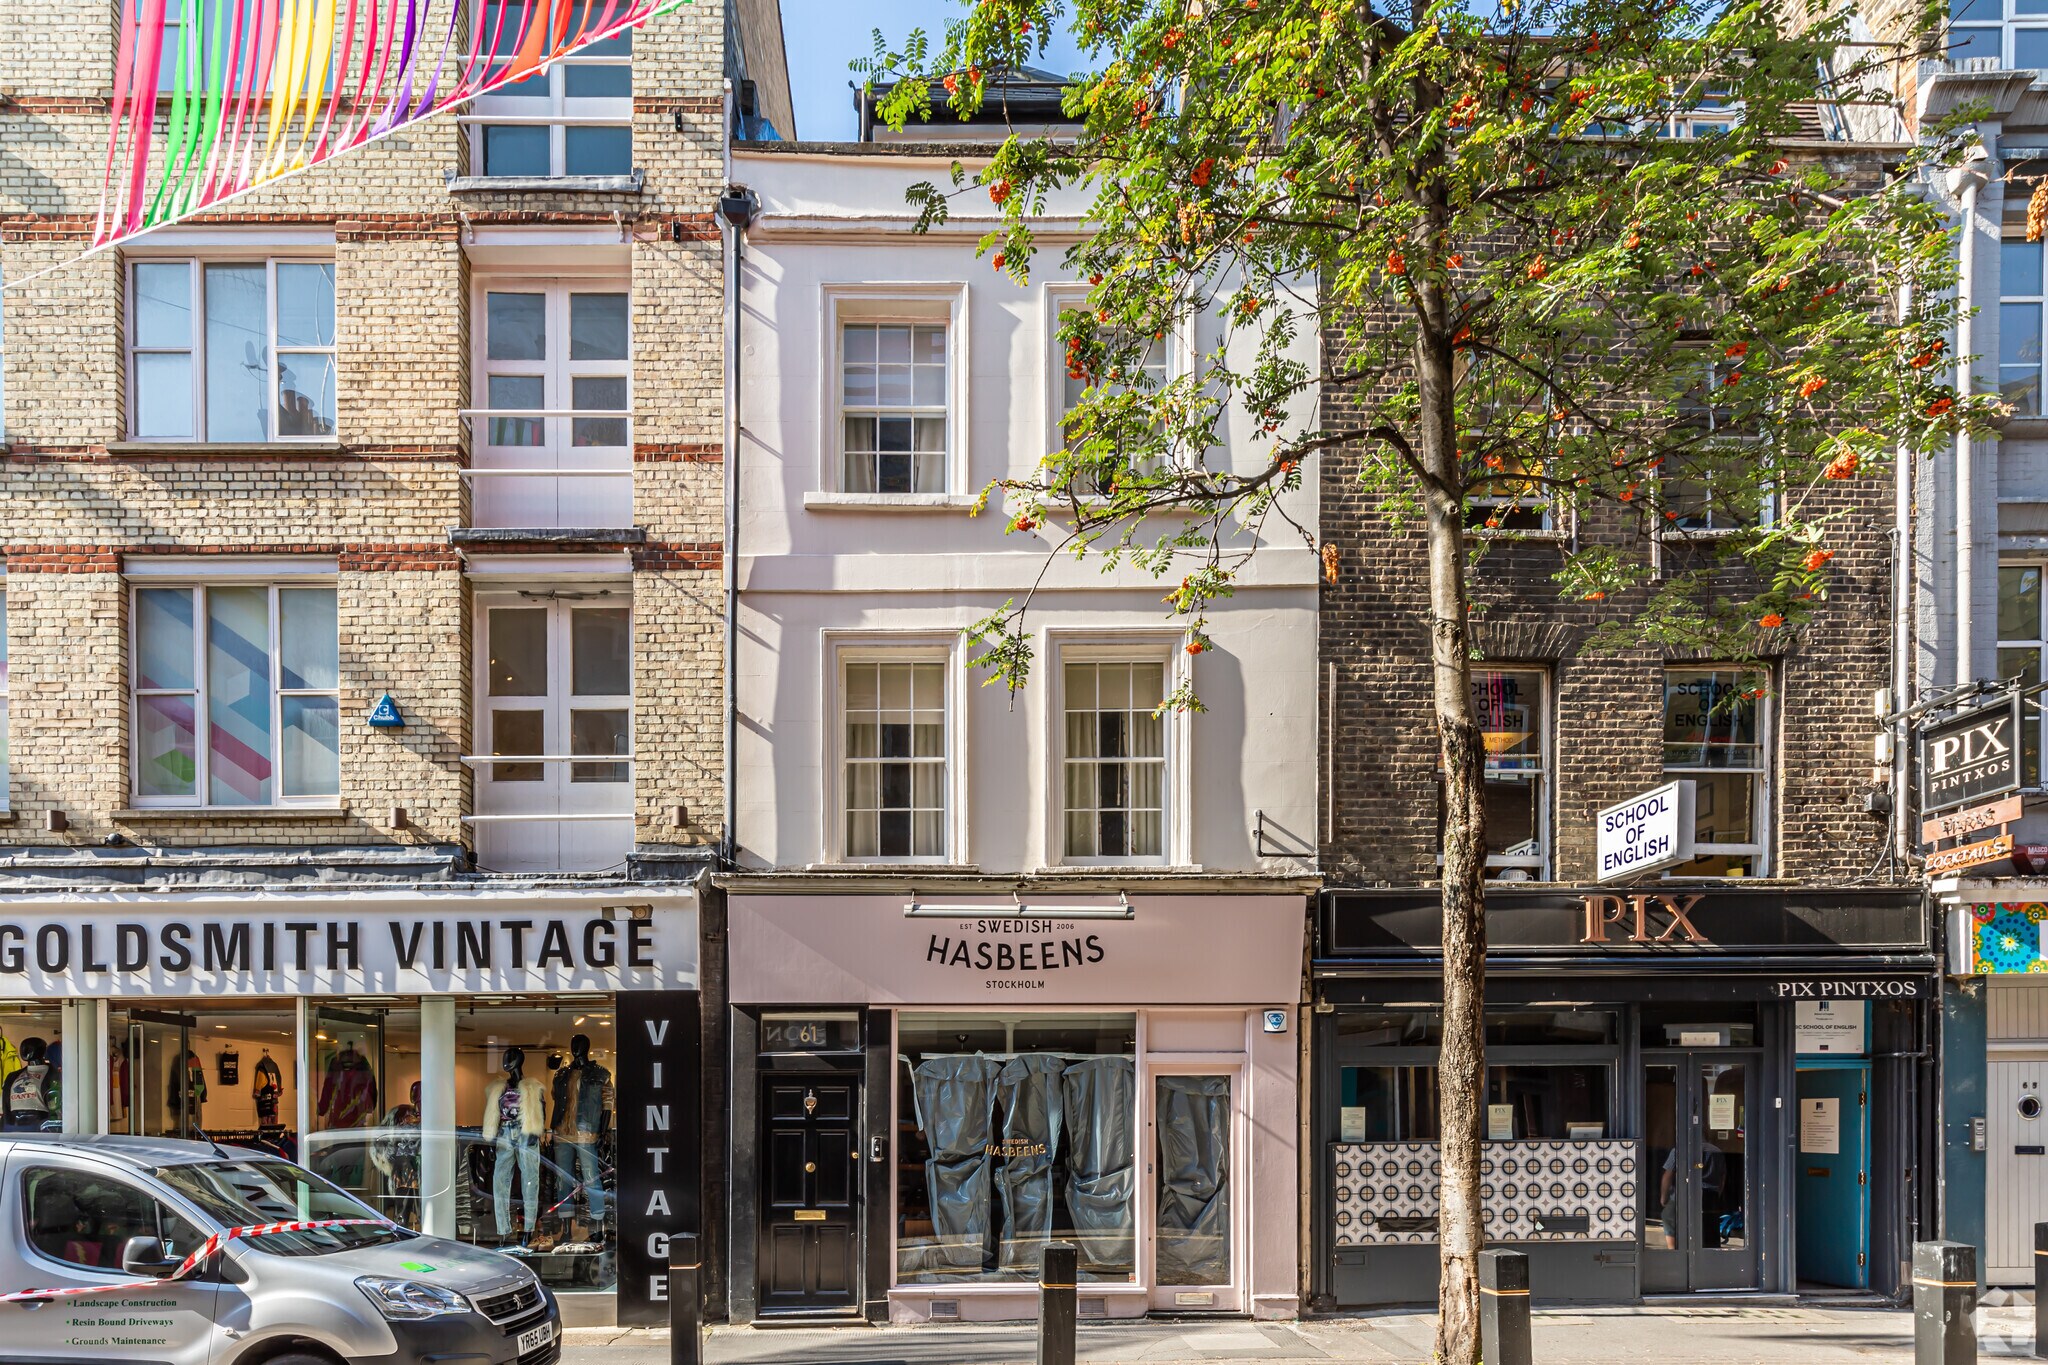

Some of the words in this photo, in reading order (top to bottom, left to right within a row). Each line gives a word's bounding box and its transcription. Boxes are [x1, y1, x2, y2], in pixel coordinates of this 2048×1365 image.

[1675, 714, 1744, 727] ENGLISH
[1930, 717, 2010, 775] PIX
[1931, 759, 2010, 793] PINTXOS
[1605, 796, 1669, 833] SCHOOL
[1625, 823, 1646, 845] OF
[1604, 834, 1669, 871] ENGLISH
[1924, 841, 2007, 870] COCKTAILS
[977, 919, 1052, 933] SWEDISH
[1580, 894, 1709, 943] PIX
[0, 922, 359, 974] GOLDSMITH
[388, 918, 655, 970] VINTAGE
[926, 934, 1105, 971] HASBEENS
[985, 980, 1045, 989] STOCKHOLM
[1777, 982, 1816, 997] PIX
[1820, 981, 1917, 997] PINTXOS
[800, 1026, 817, 1043] 61
[645, 1020, 672, 1301] VINTAGE
[984, 1143, 1047, 1157] HASBEENS
[73, 1299, 119, 1309] Landscape
[121, 1298, 177, 1308] Construction
[72, 1318, 96, 1327] Resin
[98, 1318, 126, 1327] Bound
[128, 1318, 174, 1328] Driveways
[71, 1336, 109, 1346] Grounds
[111, 1336, 167, 1345] Maintenance
[520, 1329, 539, 1351] YR65
